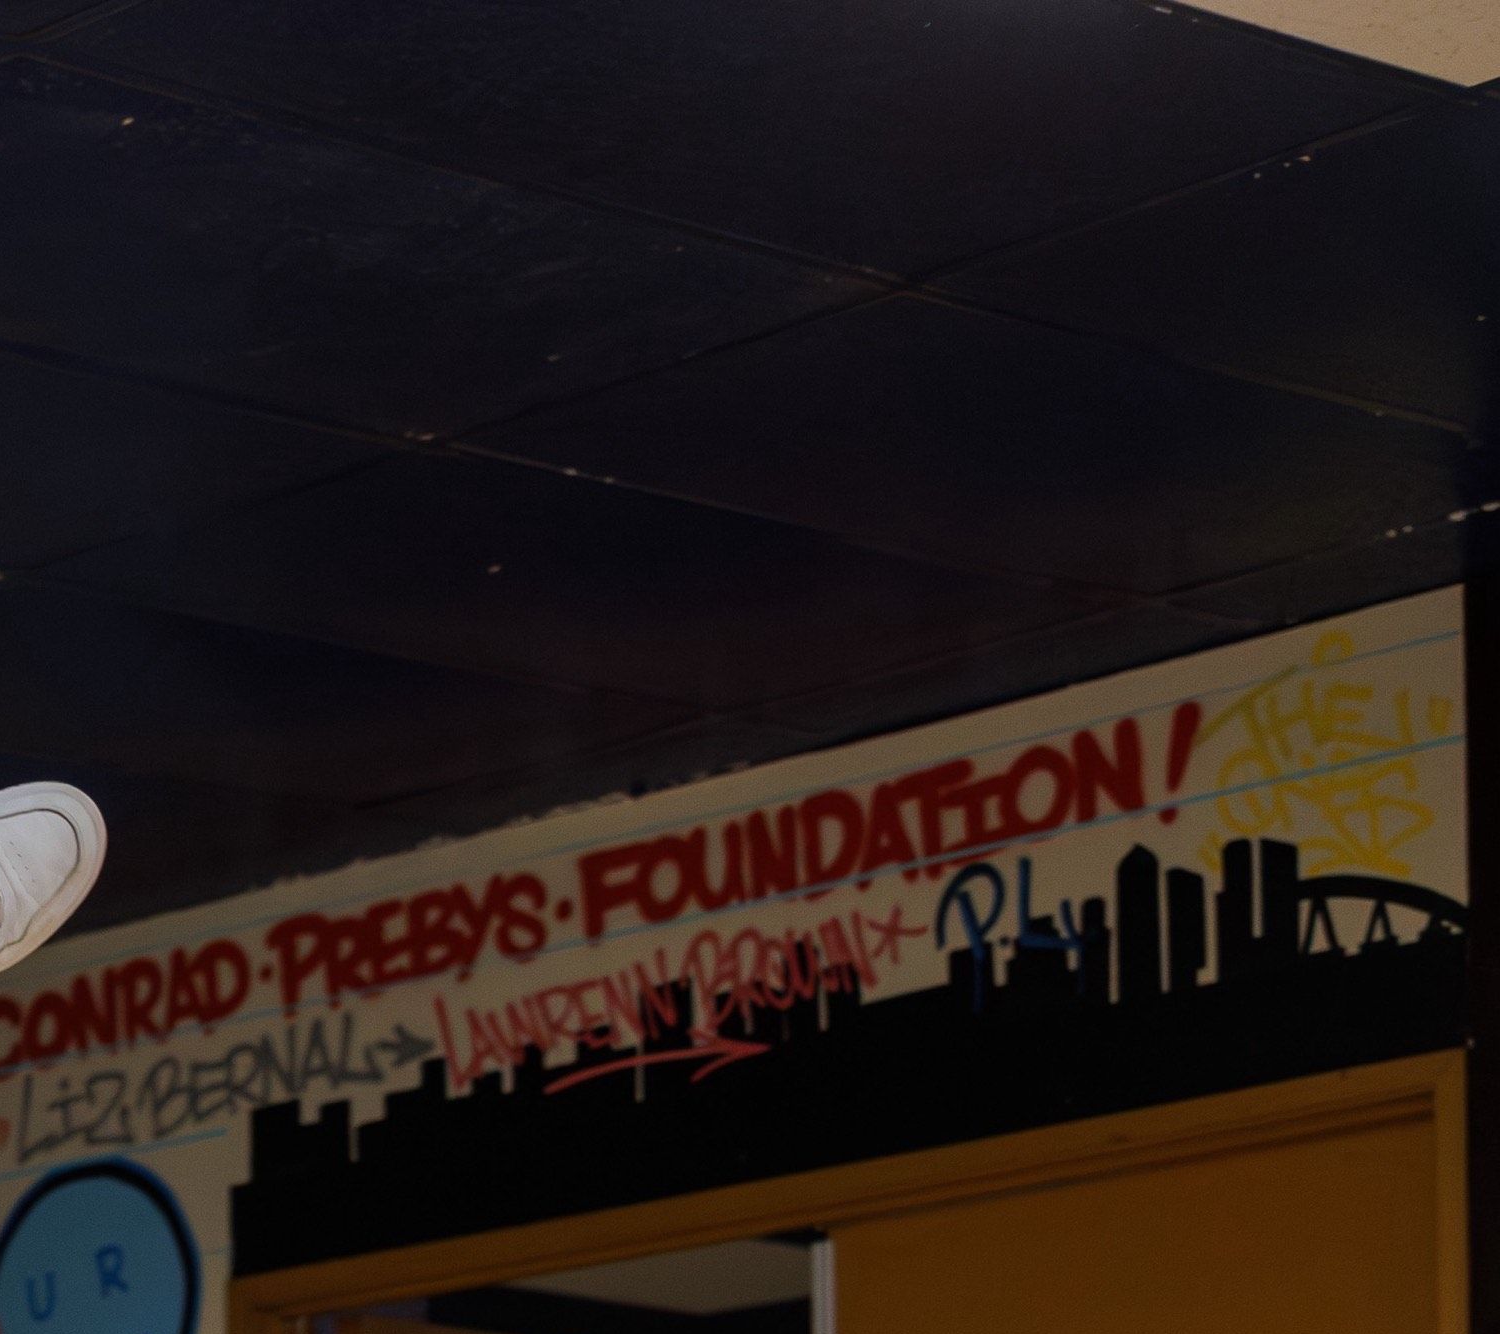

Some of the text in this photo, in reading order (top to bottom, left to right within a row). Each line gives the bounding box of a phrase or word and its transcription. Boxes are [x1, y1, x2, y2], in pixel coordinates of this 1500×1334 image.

[266, 872, 549, 1015] PREBYS
[579, 700, 1203, 948] FOUNDATION!
[23, 1244, 131, 1326] U R
